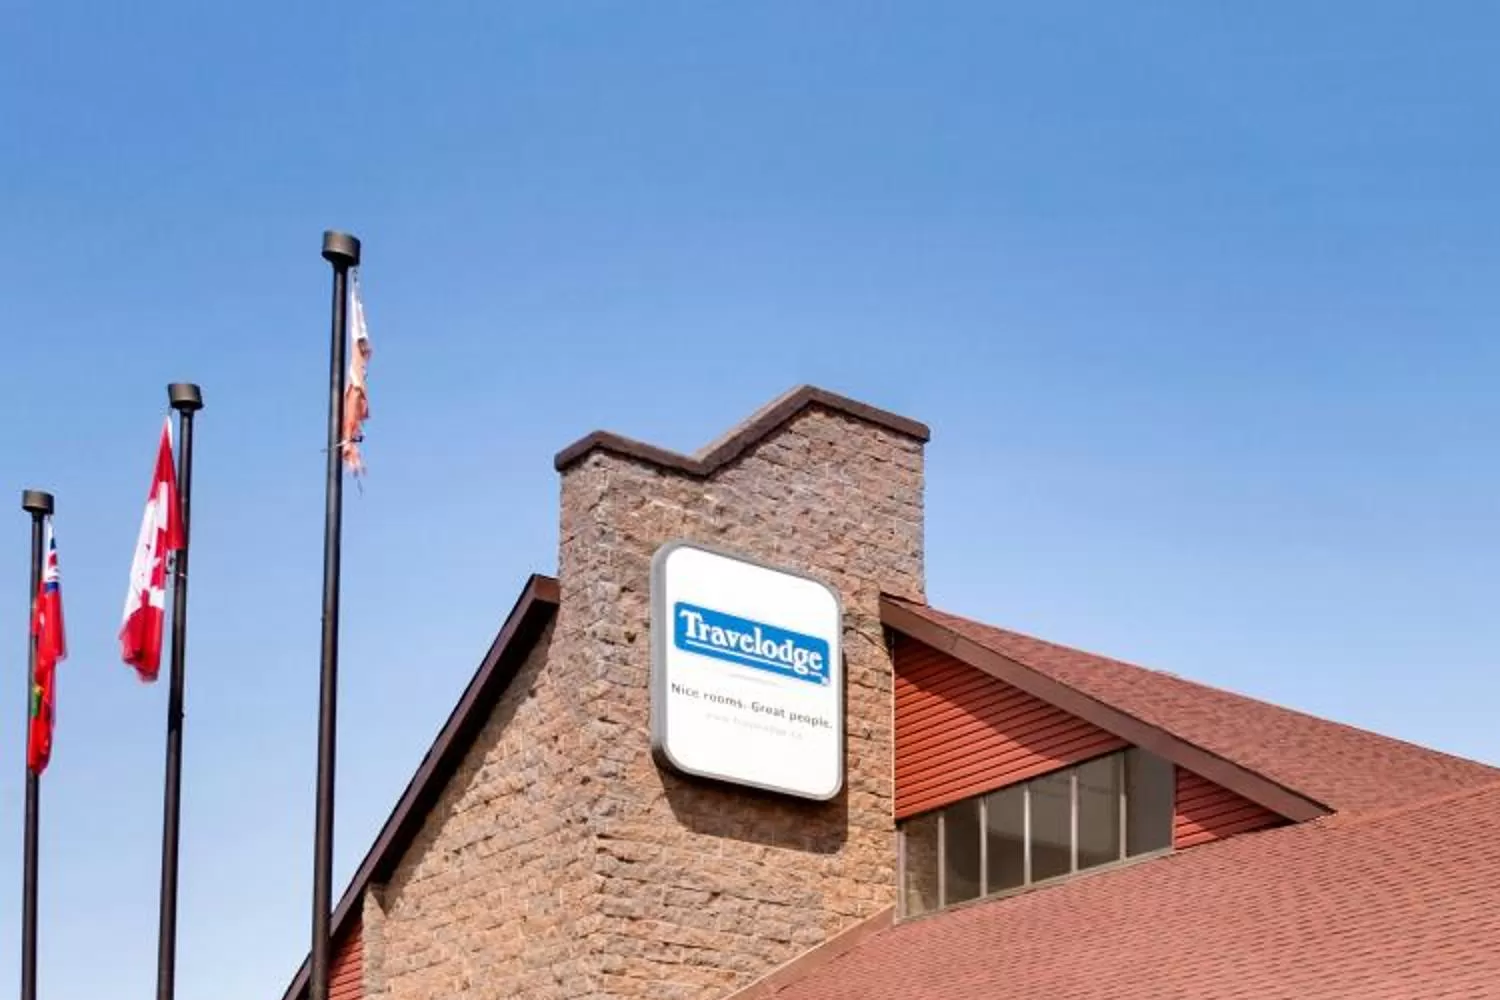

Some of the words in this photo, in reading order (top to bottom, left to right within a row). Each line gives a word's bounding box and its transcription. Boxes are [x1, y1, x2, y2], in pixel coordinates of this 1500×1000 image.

[679, 609, 824, 675] Travelodge
[671, 682, 700, 699] Nice
[703, 692, 746, 710] rooms.
[751, 701, 786, 719] Great
[789, 711, 834, 730] people.
